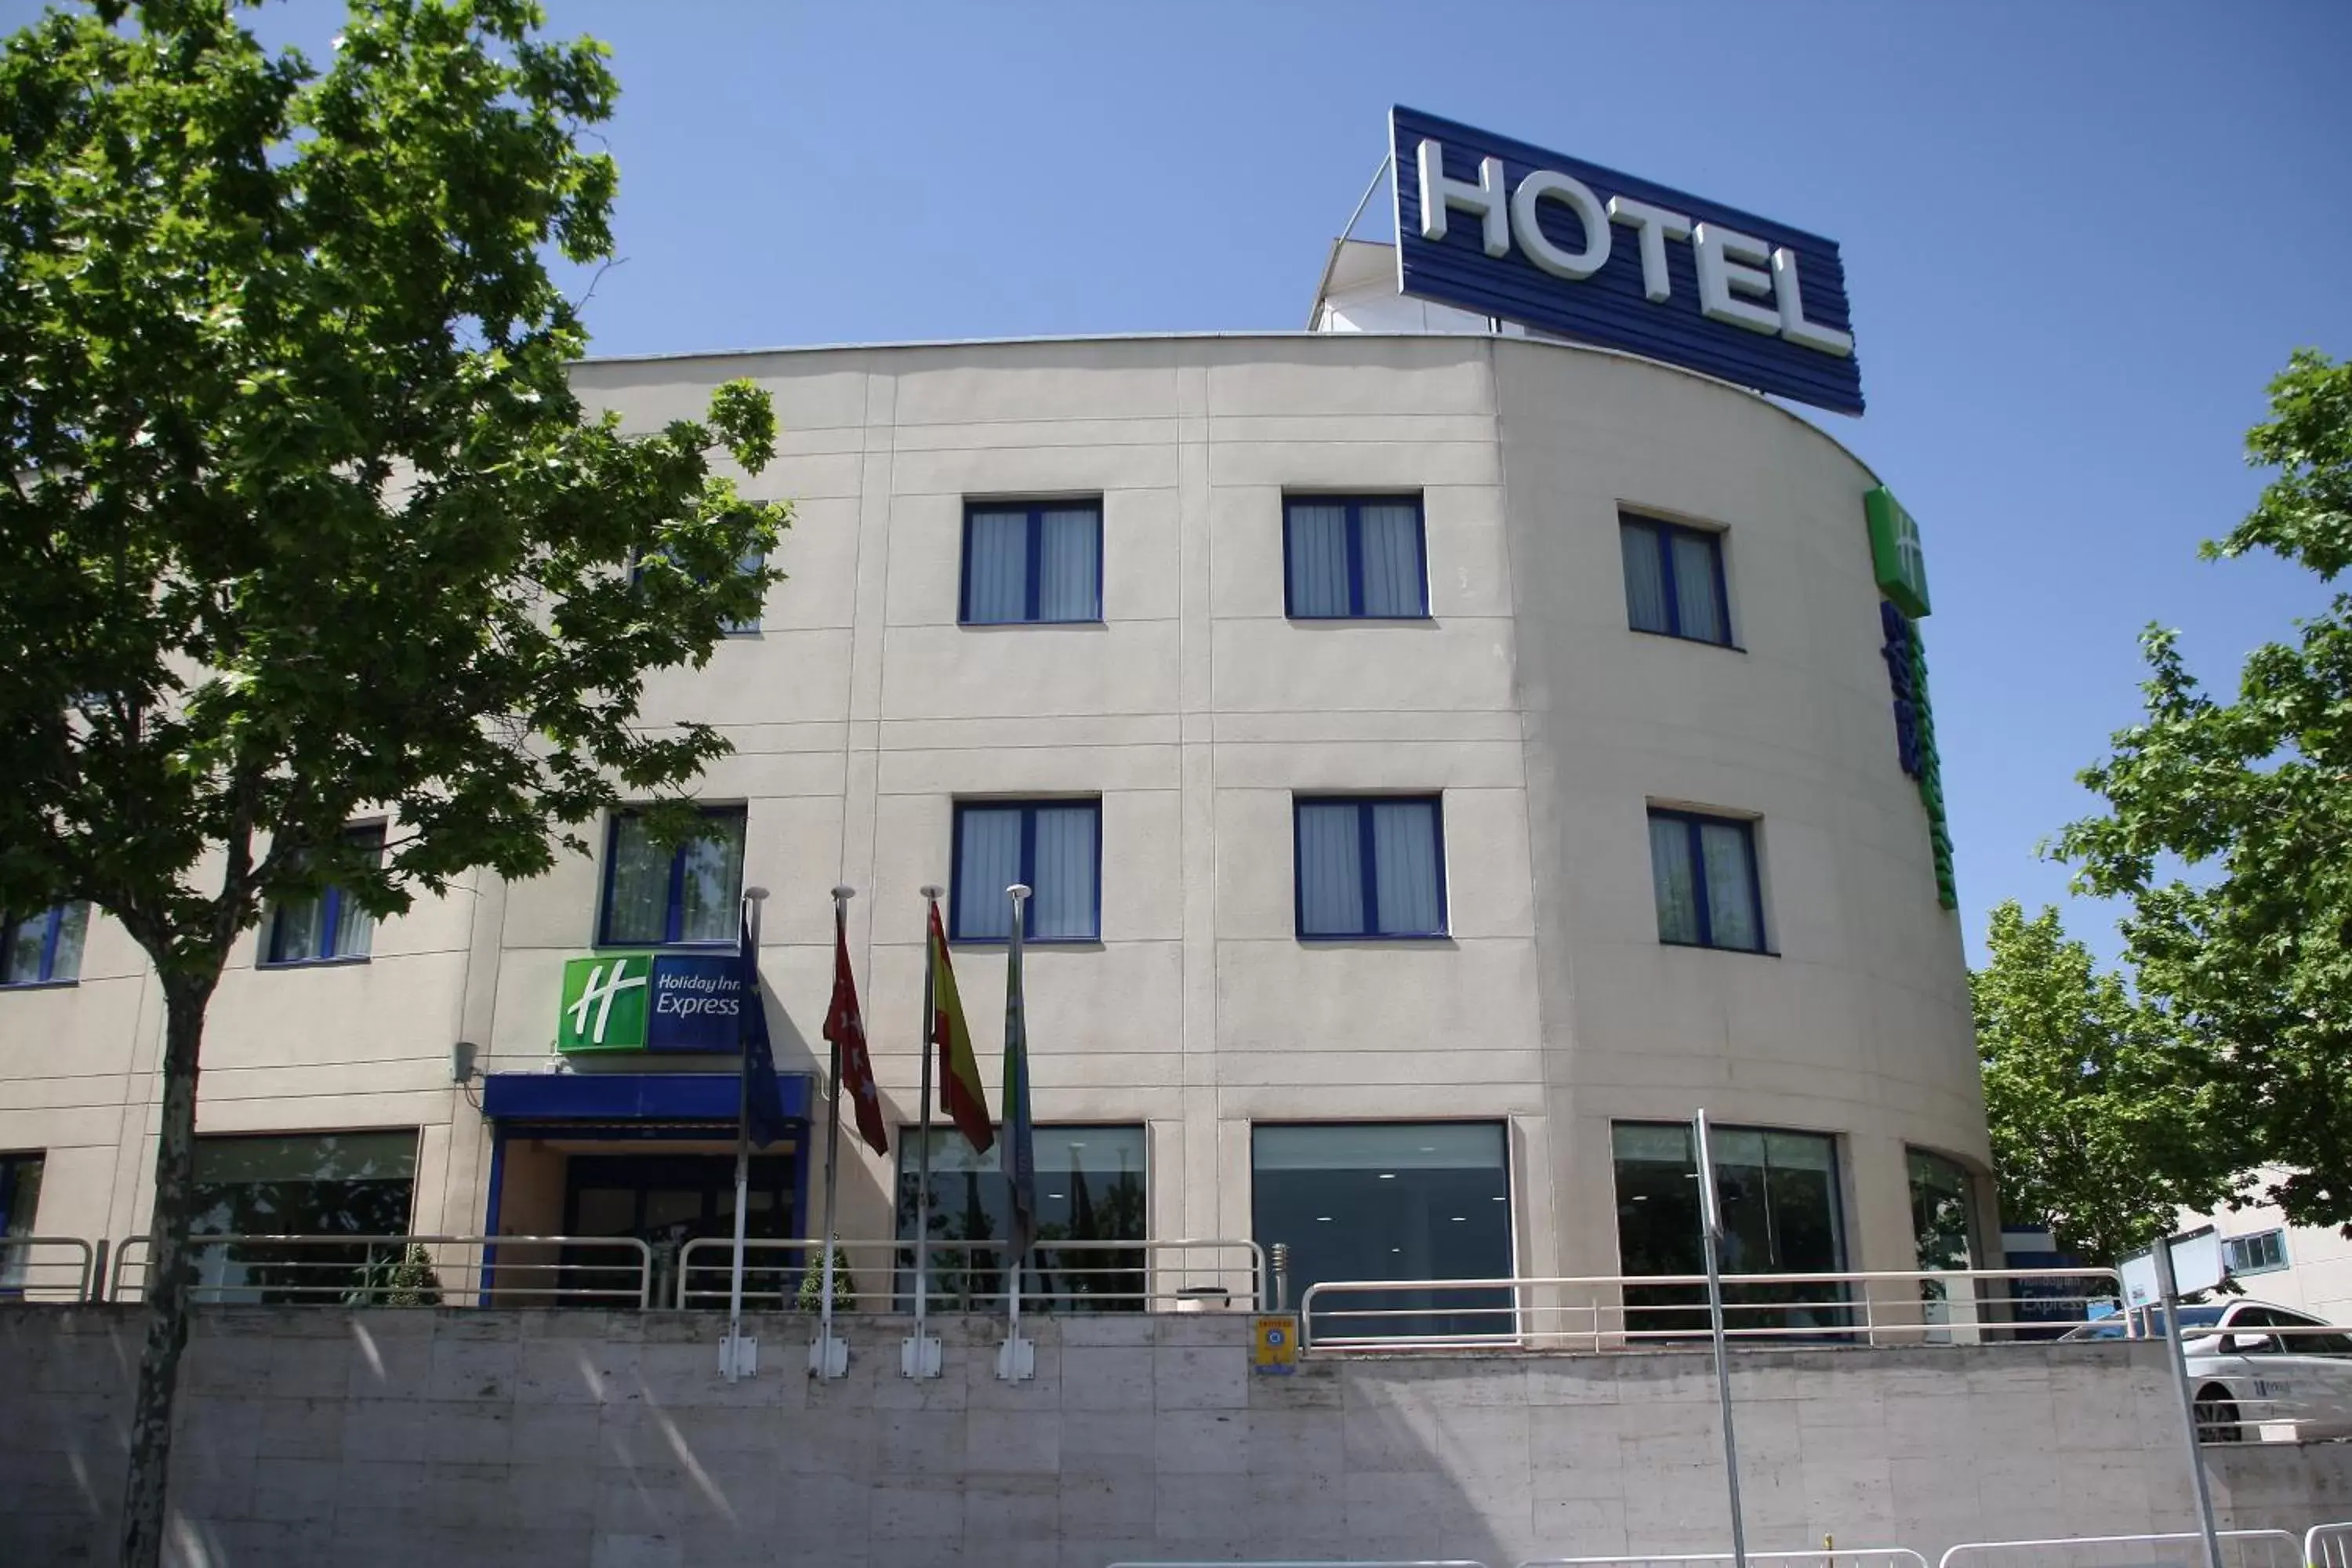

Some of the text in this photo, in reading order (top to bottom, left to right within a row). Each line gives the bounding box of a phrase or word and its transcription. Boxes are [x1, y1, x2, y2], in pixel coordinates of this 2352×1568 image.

[1417, 138, 1853, 358] HOTEL
[659, 974, 717, 993] Holiday
[656, 992, 739, 1019] Express
[2021, 1290, 2083, 1316] Express
